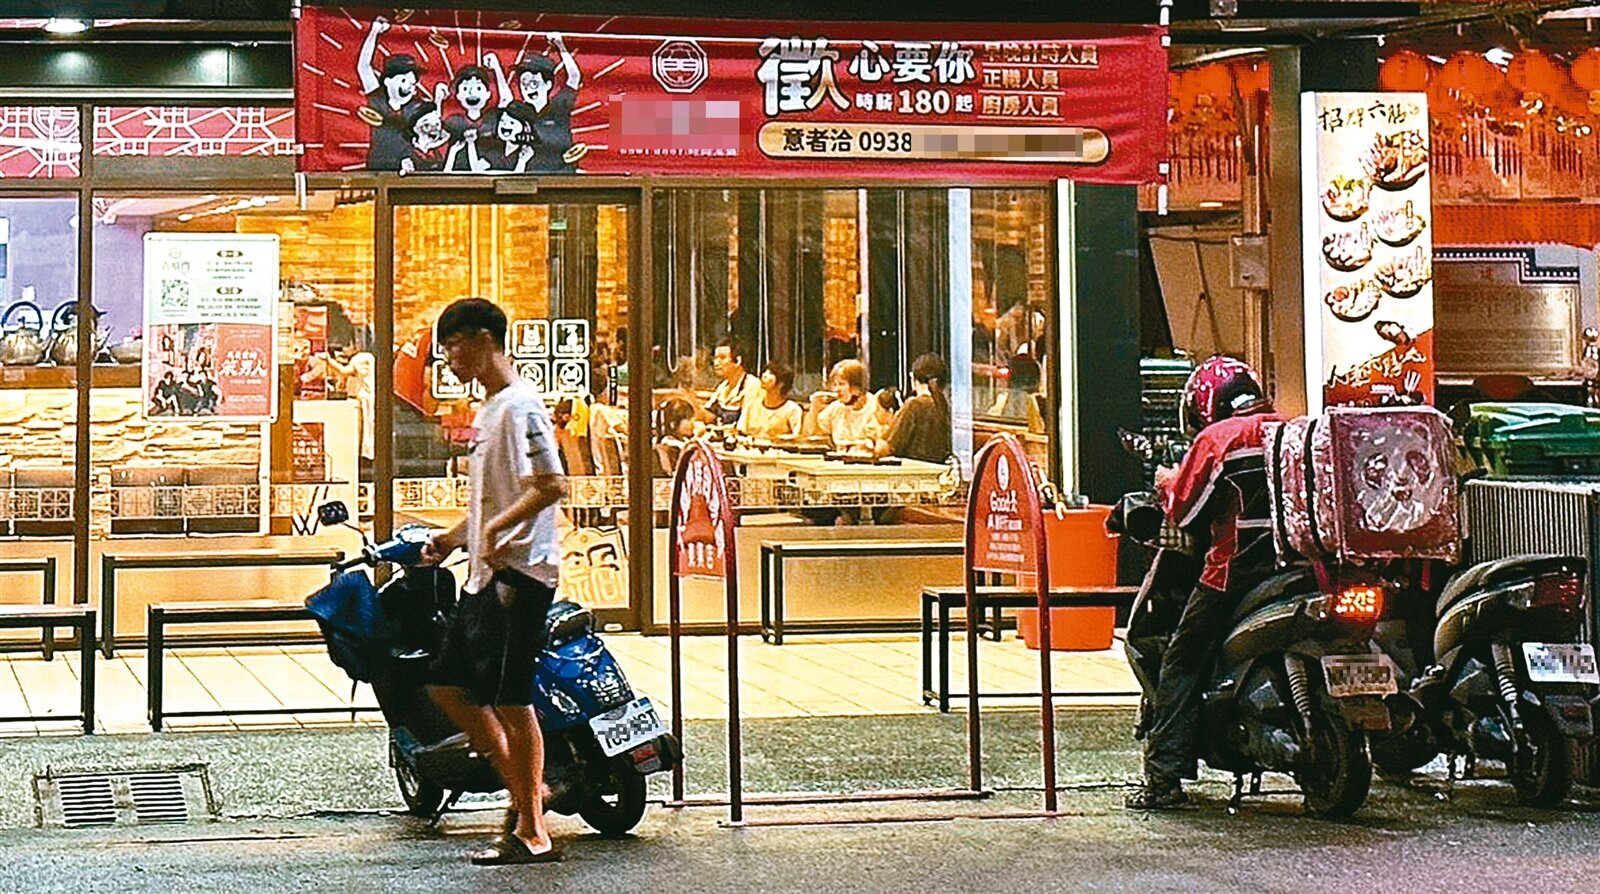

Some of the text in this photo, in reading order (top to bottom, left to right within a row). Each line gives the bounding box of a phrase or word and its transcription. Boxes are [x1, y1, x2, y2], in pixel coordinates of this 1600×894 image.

[850, 41, 975, 84] 心要你
[983, 69, 1059, 90] 正職人員
[898, 89, 950, 115] 180
[955, 95, 975, 113] 起
[783, 129, 911, 154] 意者洽 0938
